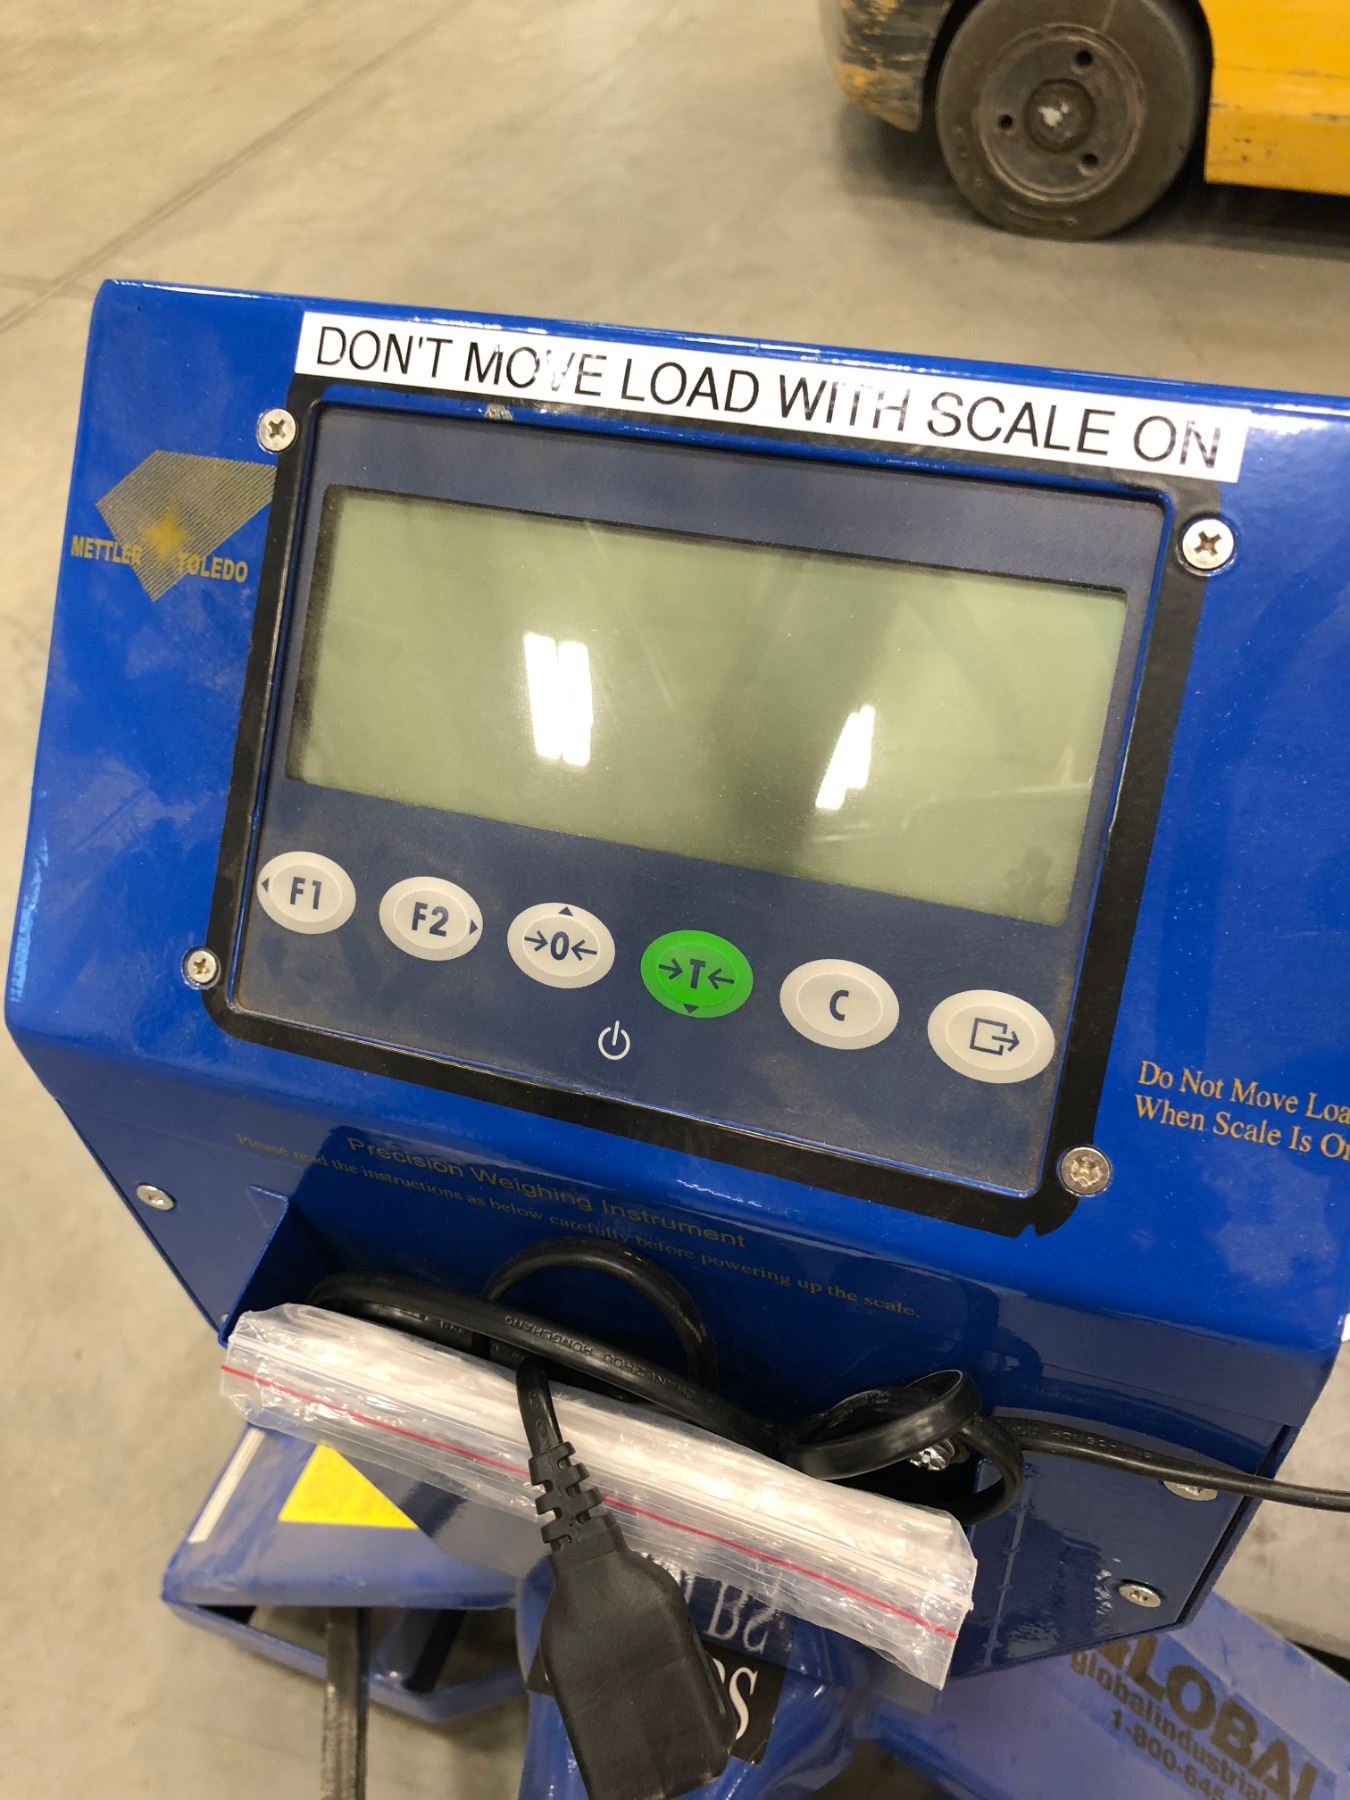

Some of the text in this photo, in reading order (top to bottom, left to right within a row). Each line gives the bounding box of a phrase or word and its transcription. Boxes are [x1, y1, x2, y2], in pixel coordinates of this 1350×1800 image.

[316, 325, 1222, 469] DON'T MOVE LOAD WITH SCALE ON
[70, 534, 249, 583] METTLER TOLEDO
[289, 875, 322, 910] F1
[410, 901, 449, 937] F2
[829, 989, 850, 1022] C
[1137, 1060, 1174, 1089] Do
[1179, 1067, 1225, 1099] Not
[1229, 1077, 1299, 1114] Move
[1135, 1093, 1205, 1132] When
[1212, 1110, 1282, 1147] Scale
[1288, 1125, 1312, 1153] Is
[346, 1137, 746, 1248] Precision Weighing Instrument
[235, 1133, 921, 1318] Please read the instructions as below carefully before powering up the scale.
